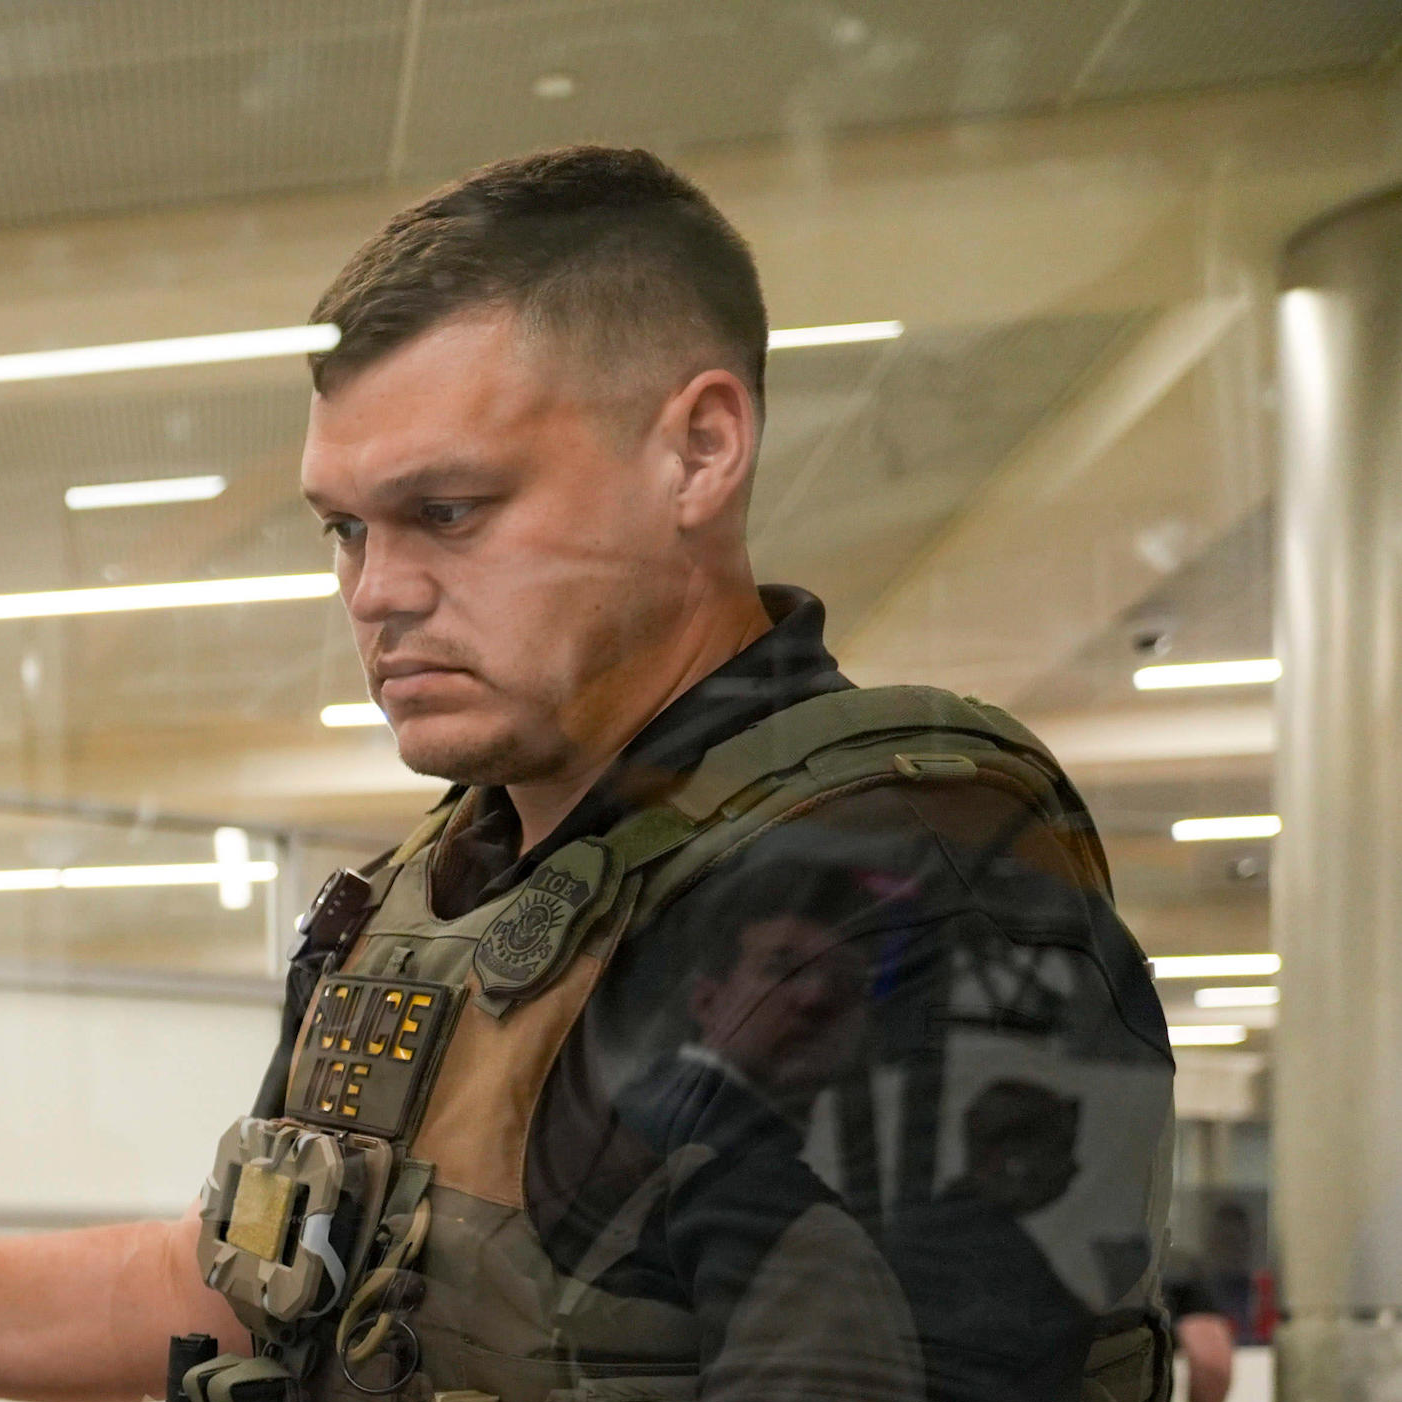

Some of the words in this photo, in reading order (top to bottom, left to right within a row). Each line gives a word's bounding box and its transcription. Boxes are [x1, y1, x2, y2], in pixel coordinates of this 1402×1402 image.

[541, 872, 577, 897] ICE
[305, 984, 435, 1063] POLICE
[303, 1057, 371, 1119] ICE
